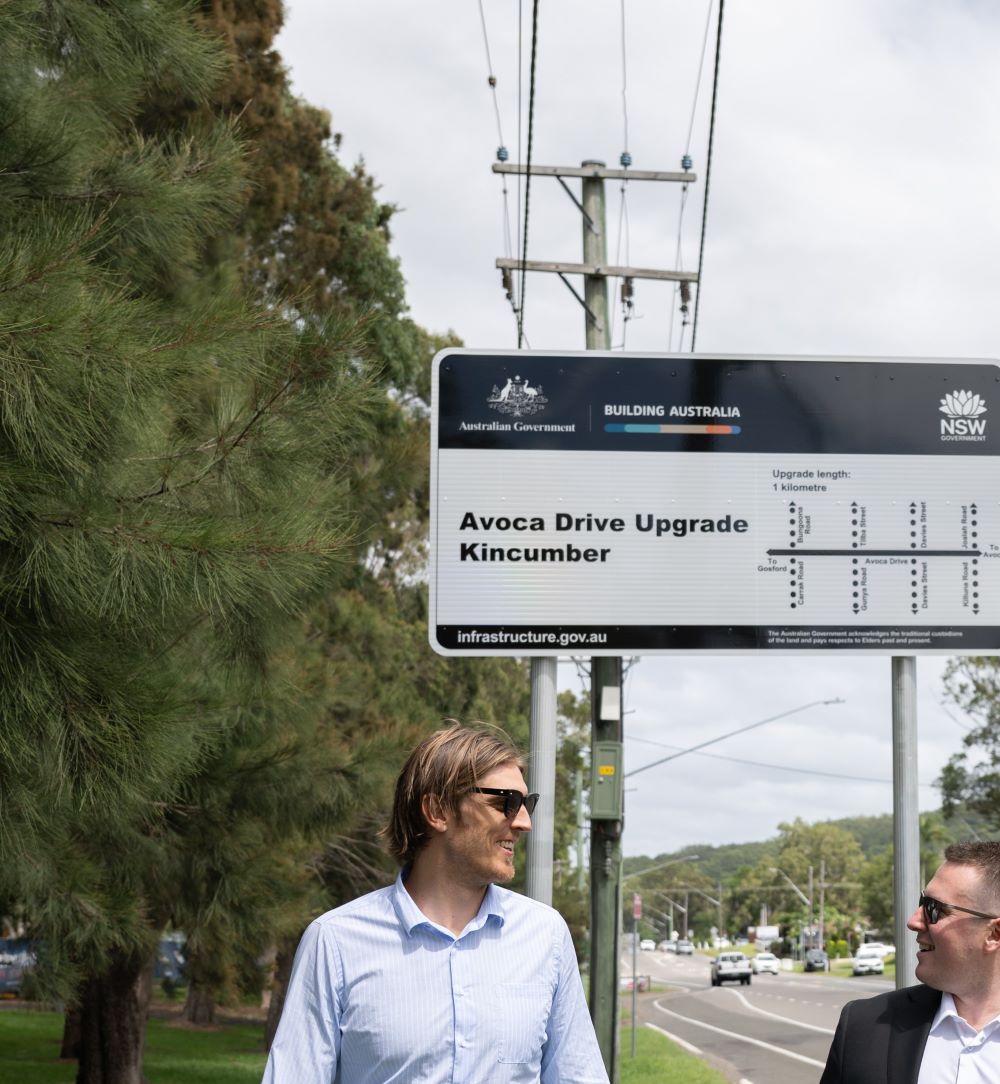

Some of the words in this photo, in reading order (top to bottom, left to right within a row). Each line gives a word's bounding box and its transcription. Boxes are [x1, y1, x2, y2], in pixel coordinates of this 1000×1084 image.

[604, 404, 665, 417] BUILDING
[669, 406, 741, 418] AUSTRALIA
[459, 421, 510, 432] Australian
[513, 421, 575, 433] Government
[940, 419, 986, 435] NSW
[772, 469, 814, 479] Upgrade
[817, 470, 851, 479] length:
[773, 483, 778, 491] 1
[781, 483, 827, 492] kilometre
[459, 512, 545, 531] Avoca
[555, 513, 626, 532] Drive
[635, 514, 749, 537] Upgrade
[459, 543, 611, 563] Kincumber
[860, 587, 869, 612] Gunya
[457, 630, 607, 646] infrastructure.gov.au
